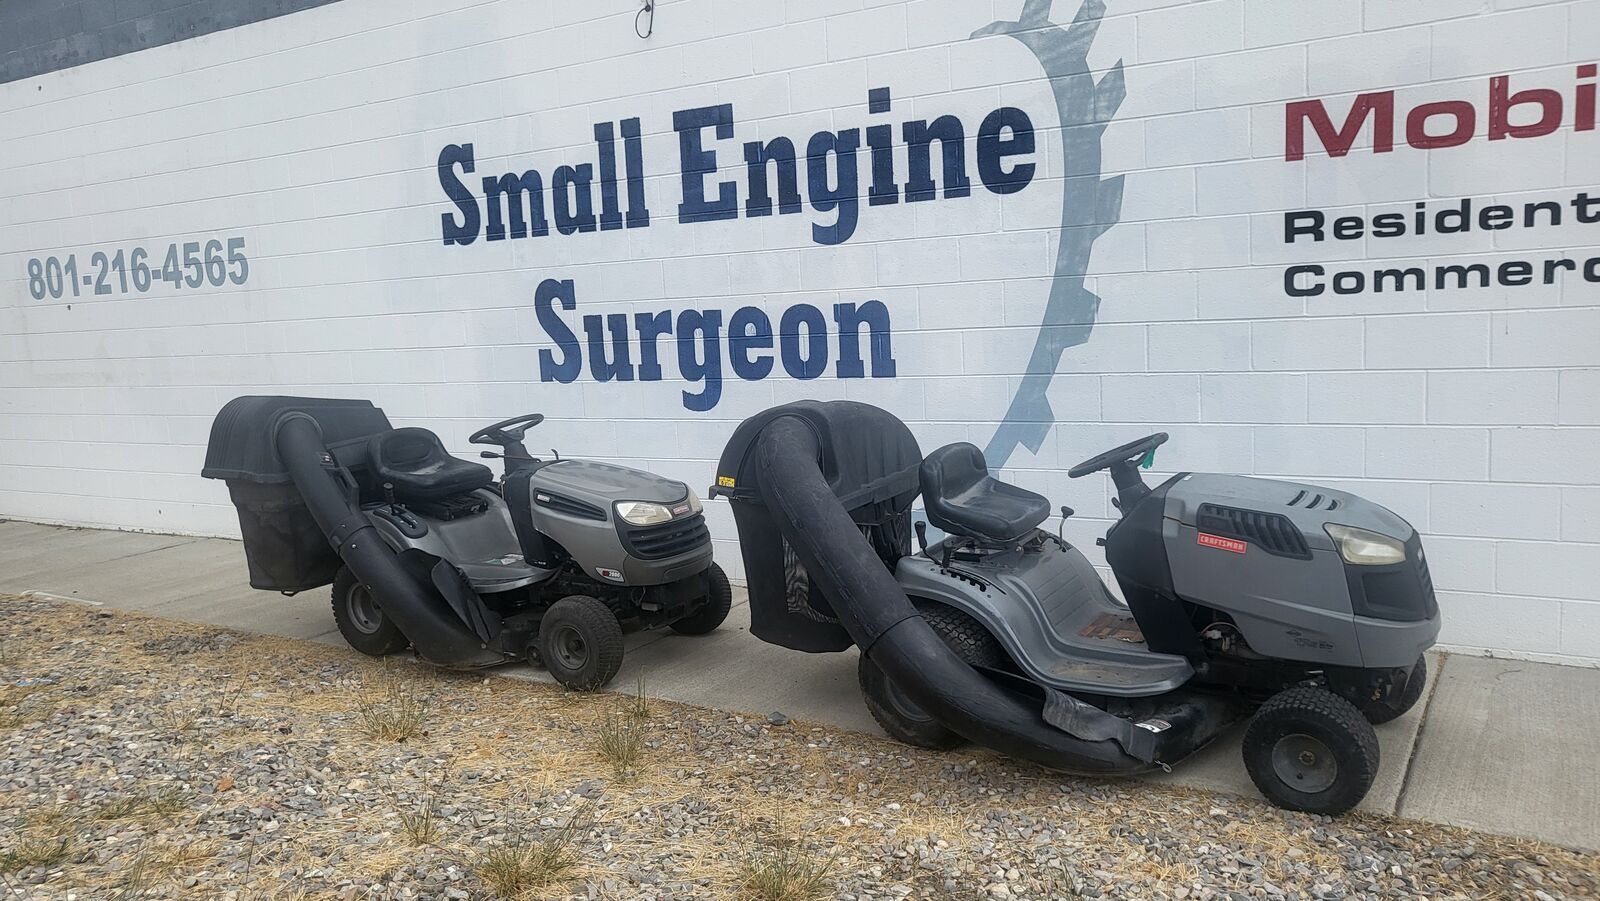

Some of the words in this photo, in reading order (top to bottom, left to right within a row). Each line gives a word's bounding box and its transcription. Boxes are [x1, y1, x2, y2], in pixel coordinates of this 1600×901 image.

[1285, 64, 1597, 162] Mobi
[437, 117, 650, 246] Small
[673, 87, 1036, 245] Engine
[1285, 192, 1600, 244] Resident
[27, 237, 249, 300] 801-216-4565
[534, 279, 897, 412] Surgeon
[1199, 535, 1244, 551] CRAFTSMAN
